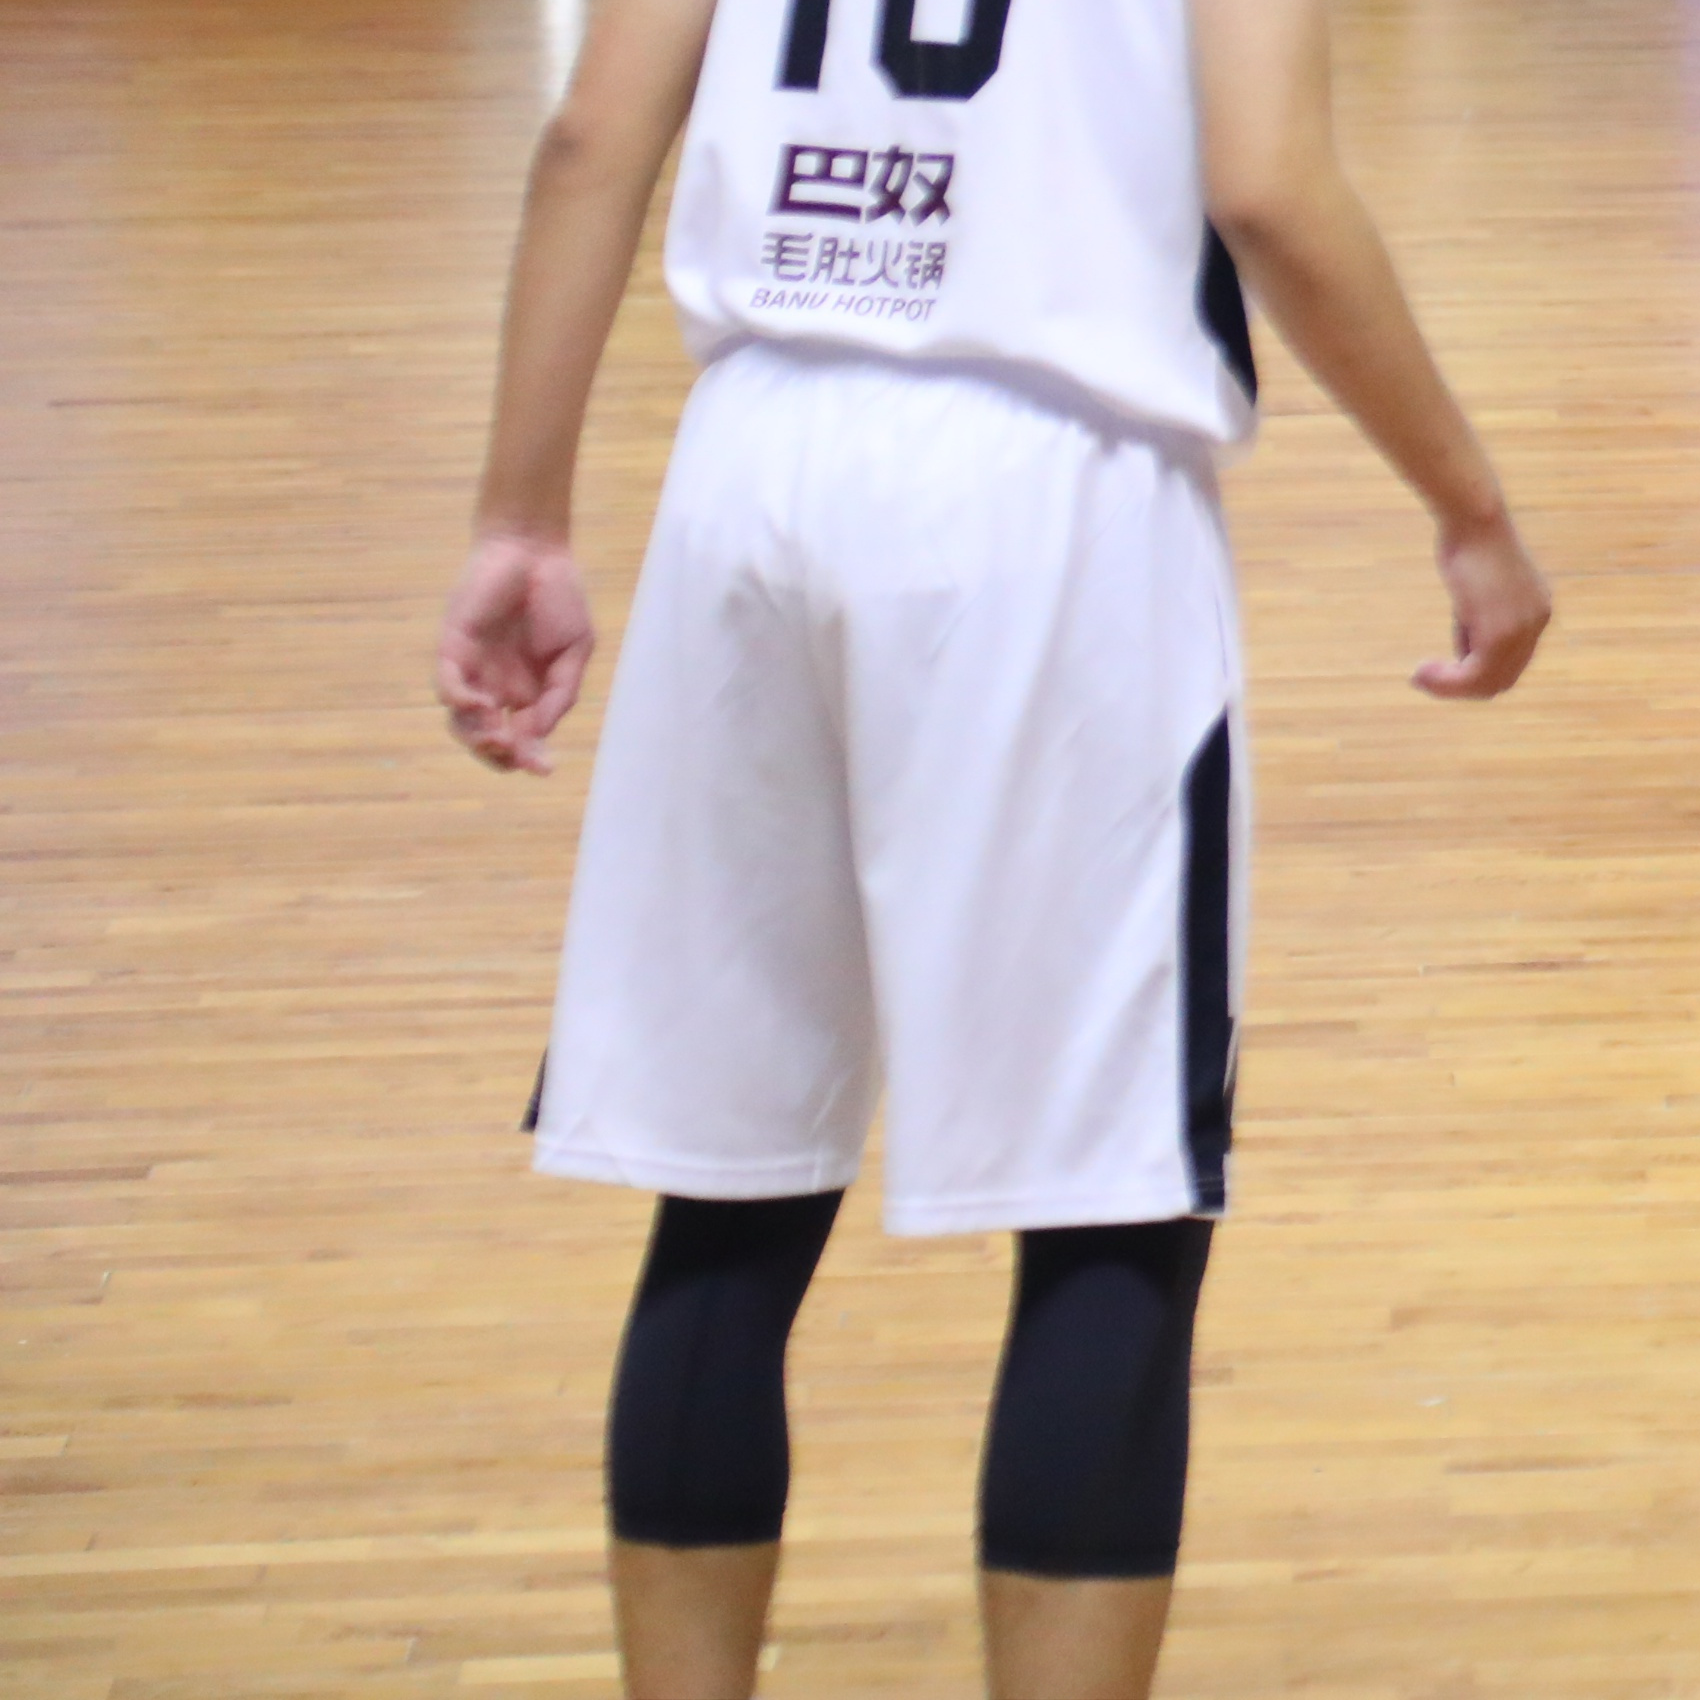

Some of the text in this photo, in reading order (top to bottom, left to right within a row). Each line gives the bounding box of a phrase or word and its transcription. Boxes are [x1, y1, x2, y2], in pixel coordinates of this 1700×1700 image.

[766, 143, 955, 228] 巴奴
[760, 232, 948, 290] 毛肚火锅
[749, 287, 938, 322] BANU HOTPOT
